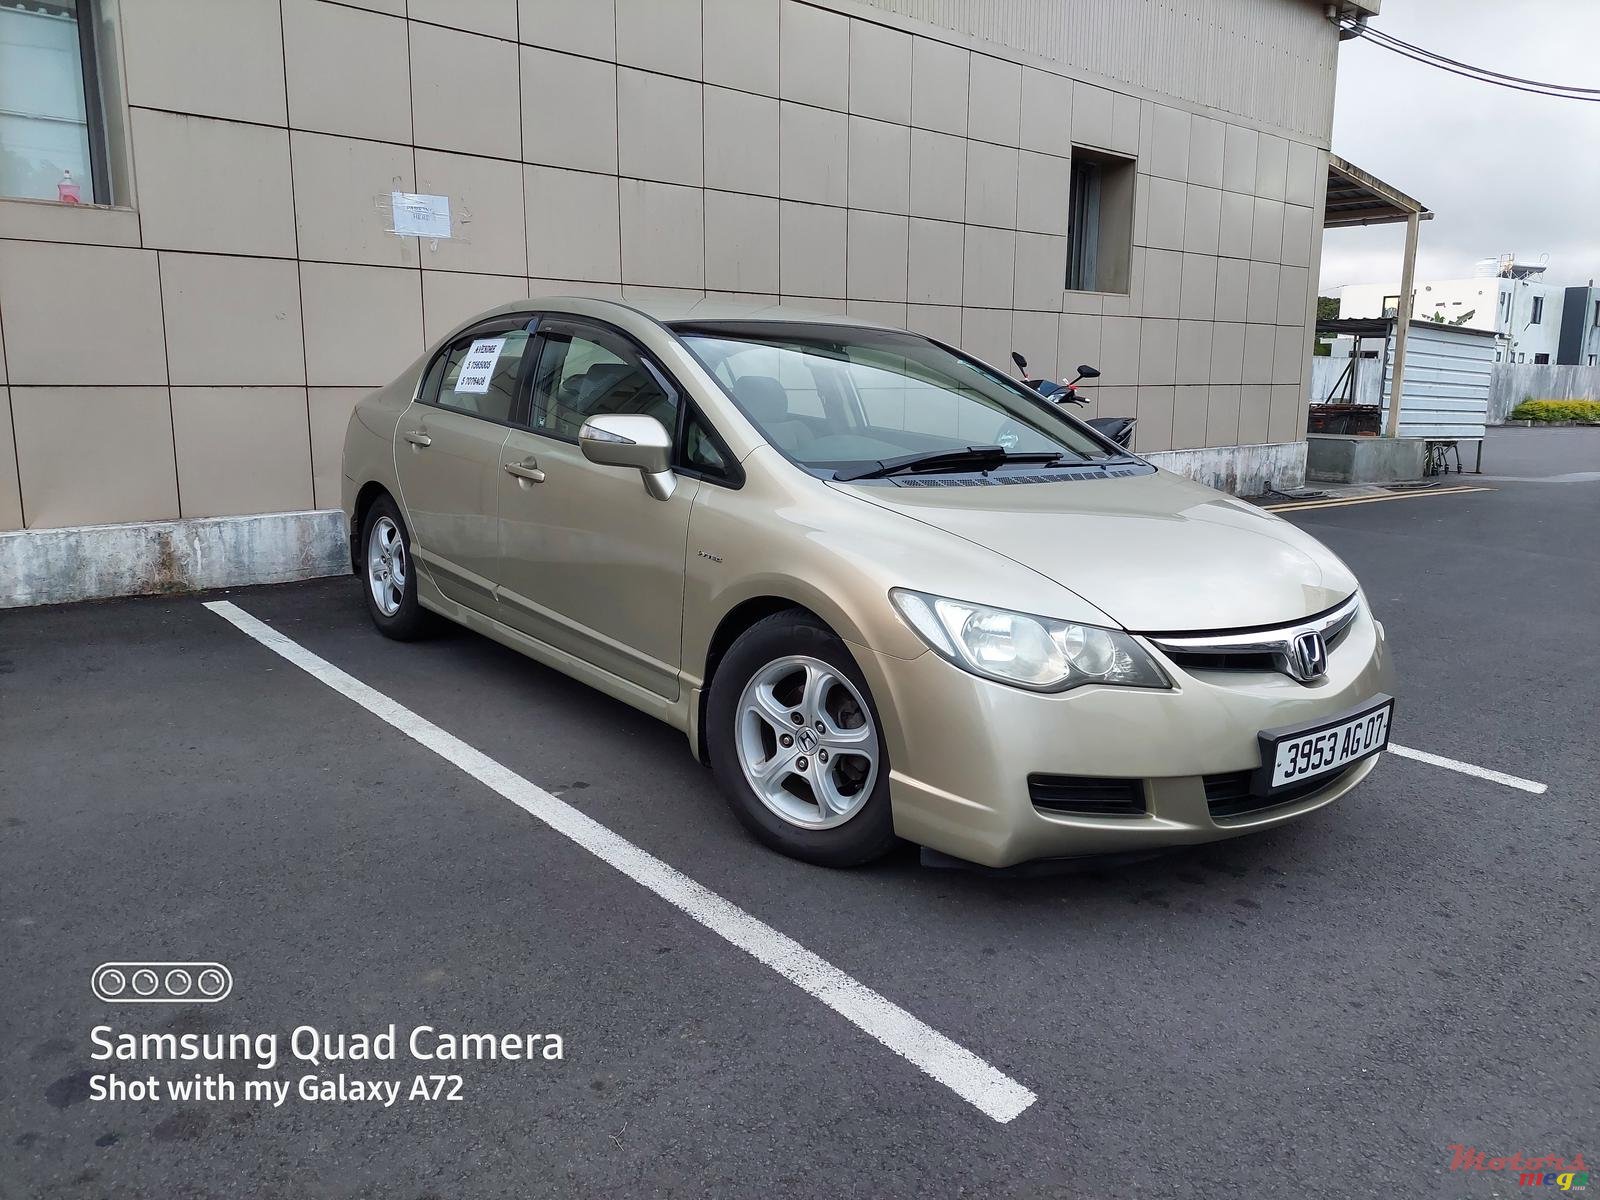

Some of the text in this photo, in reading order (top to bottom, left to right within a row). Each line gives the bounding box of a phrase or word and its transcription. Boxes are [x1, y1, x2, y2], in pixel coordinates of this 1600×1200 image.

[1284, 712, 1385, 779] 3953 AG 07
